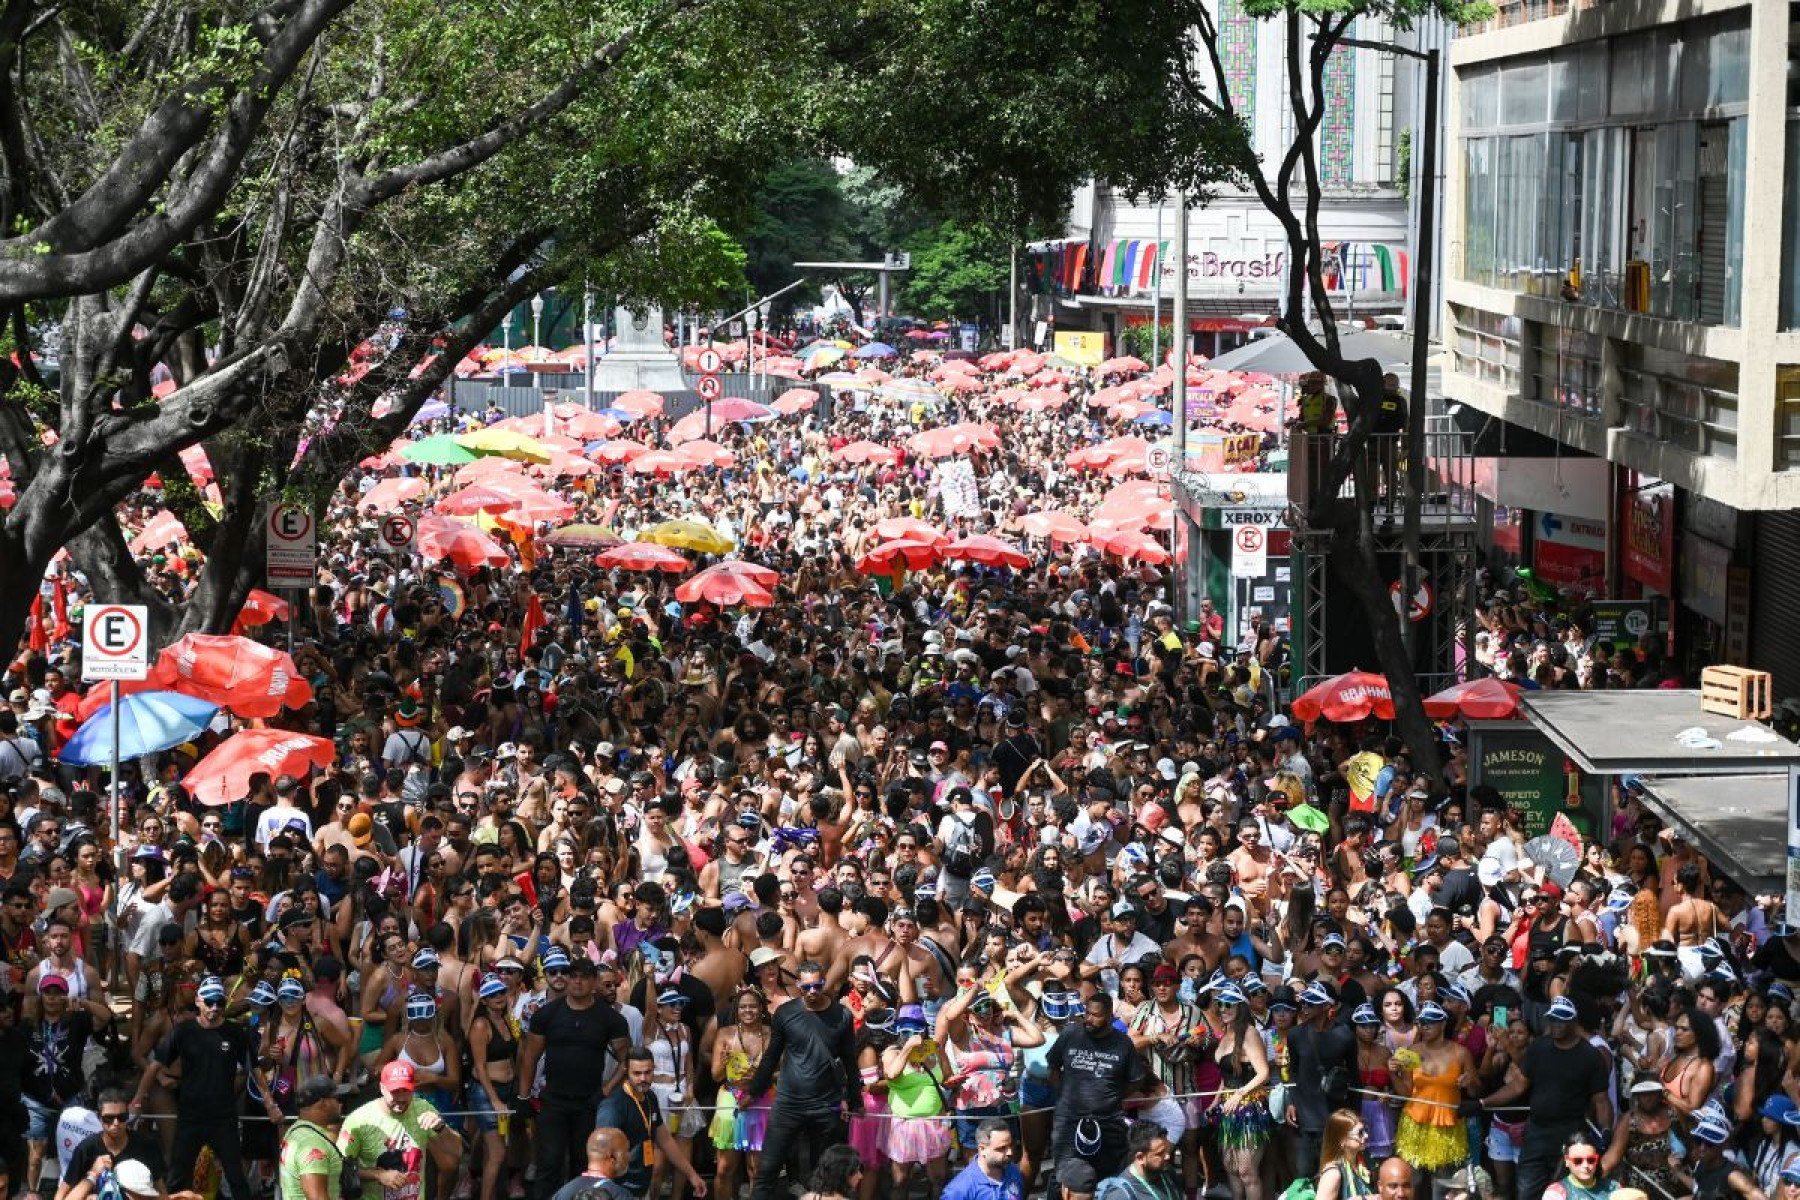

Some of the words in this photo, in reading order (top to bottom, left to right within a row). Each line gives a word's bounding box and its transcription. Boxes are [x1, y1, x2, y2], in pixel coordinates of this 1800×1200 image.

[1202, 251, 1284, 277] Brasil
[283, 510, 298, 534] E
[1225, 512, 1273, 524] XEROX
[105, 616, 126, 647] E
[1483, 749, 1544, 766] JAMESON
